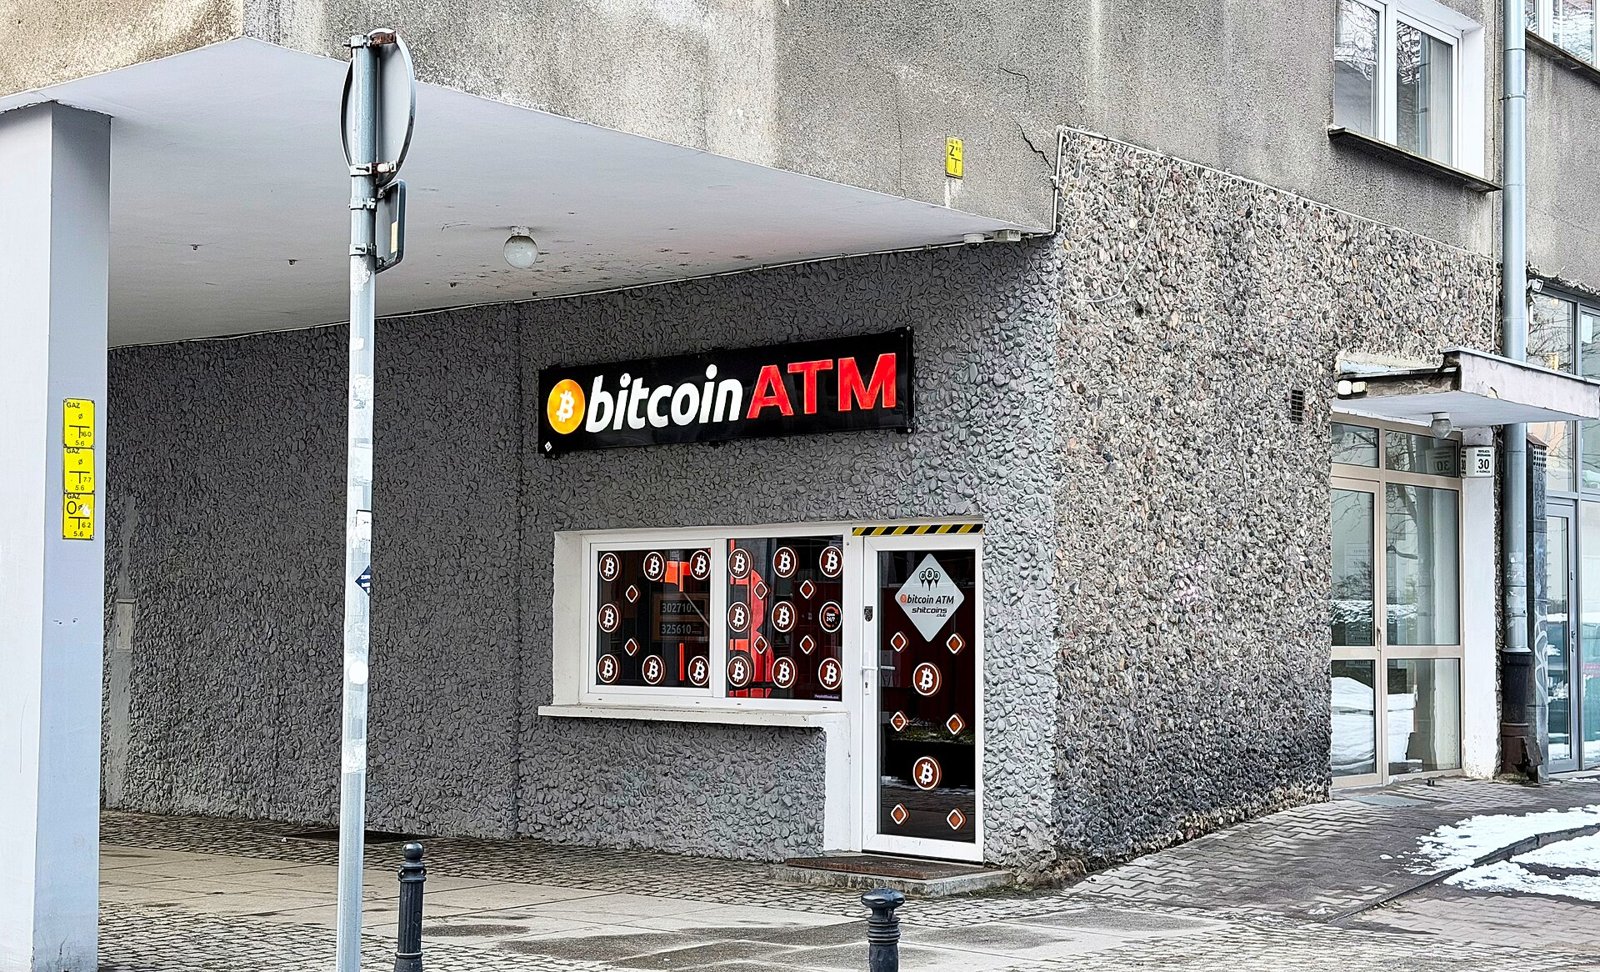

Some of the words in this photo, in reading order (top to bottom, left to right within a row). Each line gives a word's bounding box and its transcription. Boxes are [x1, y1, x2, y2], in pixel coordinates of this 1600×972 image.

[585, 363, 743, 433] bitcoin
[746, 352, 897, 419] ATM
[1478, 458, 1490, 470] 30
[907, 594, 934, 604] bitcoin
[935, 595, 955, 604] ATM
